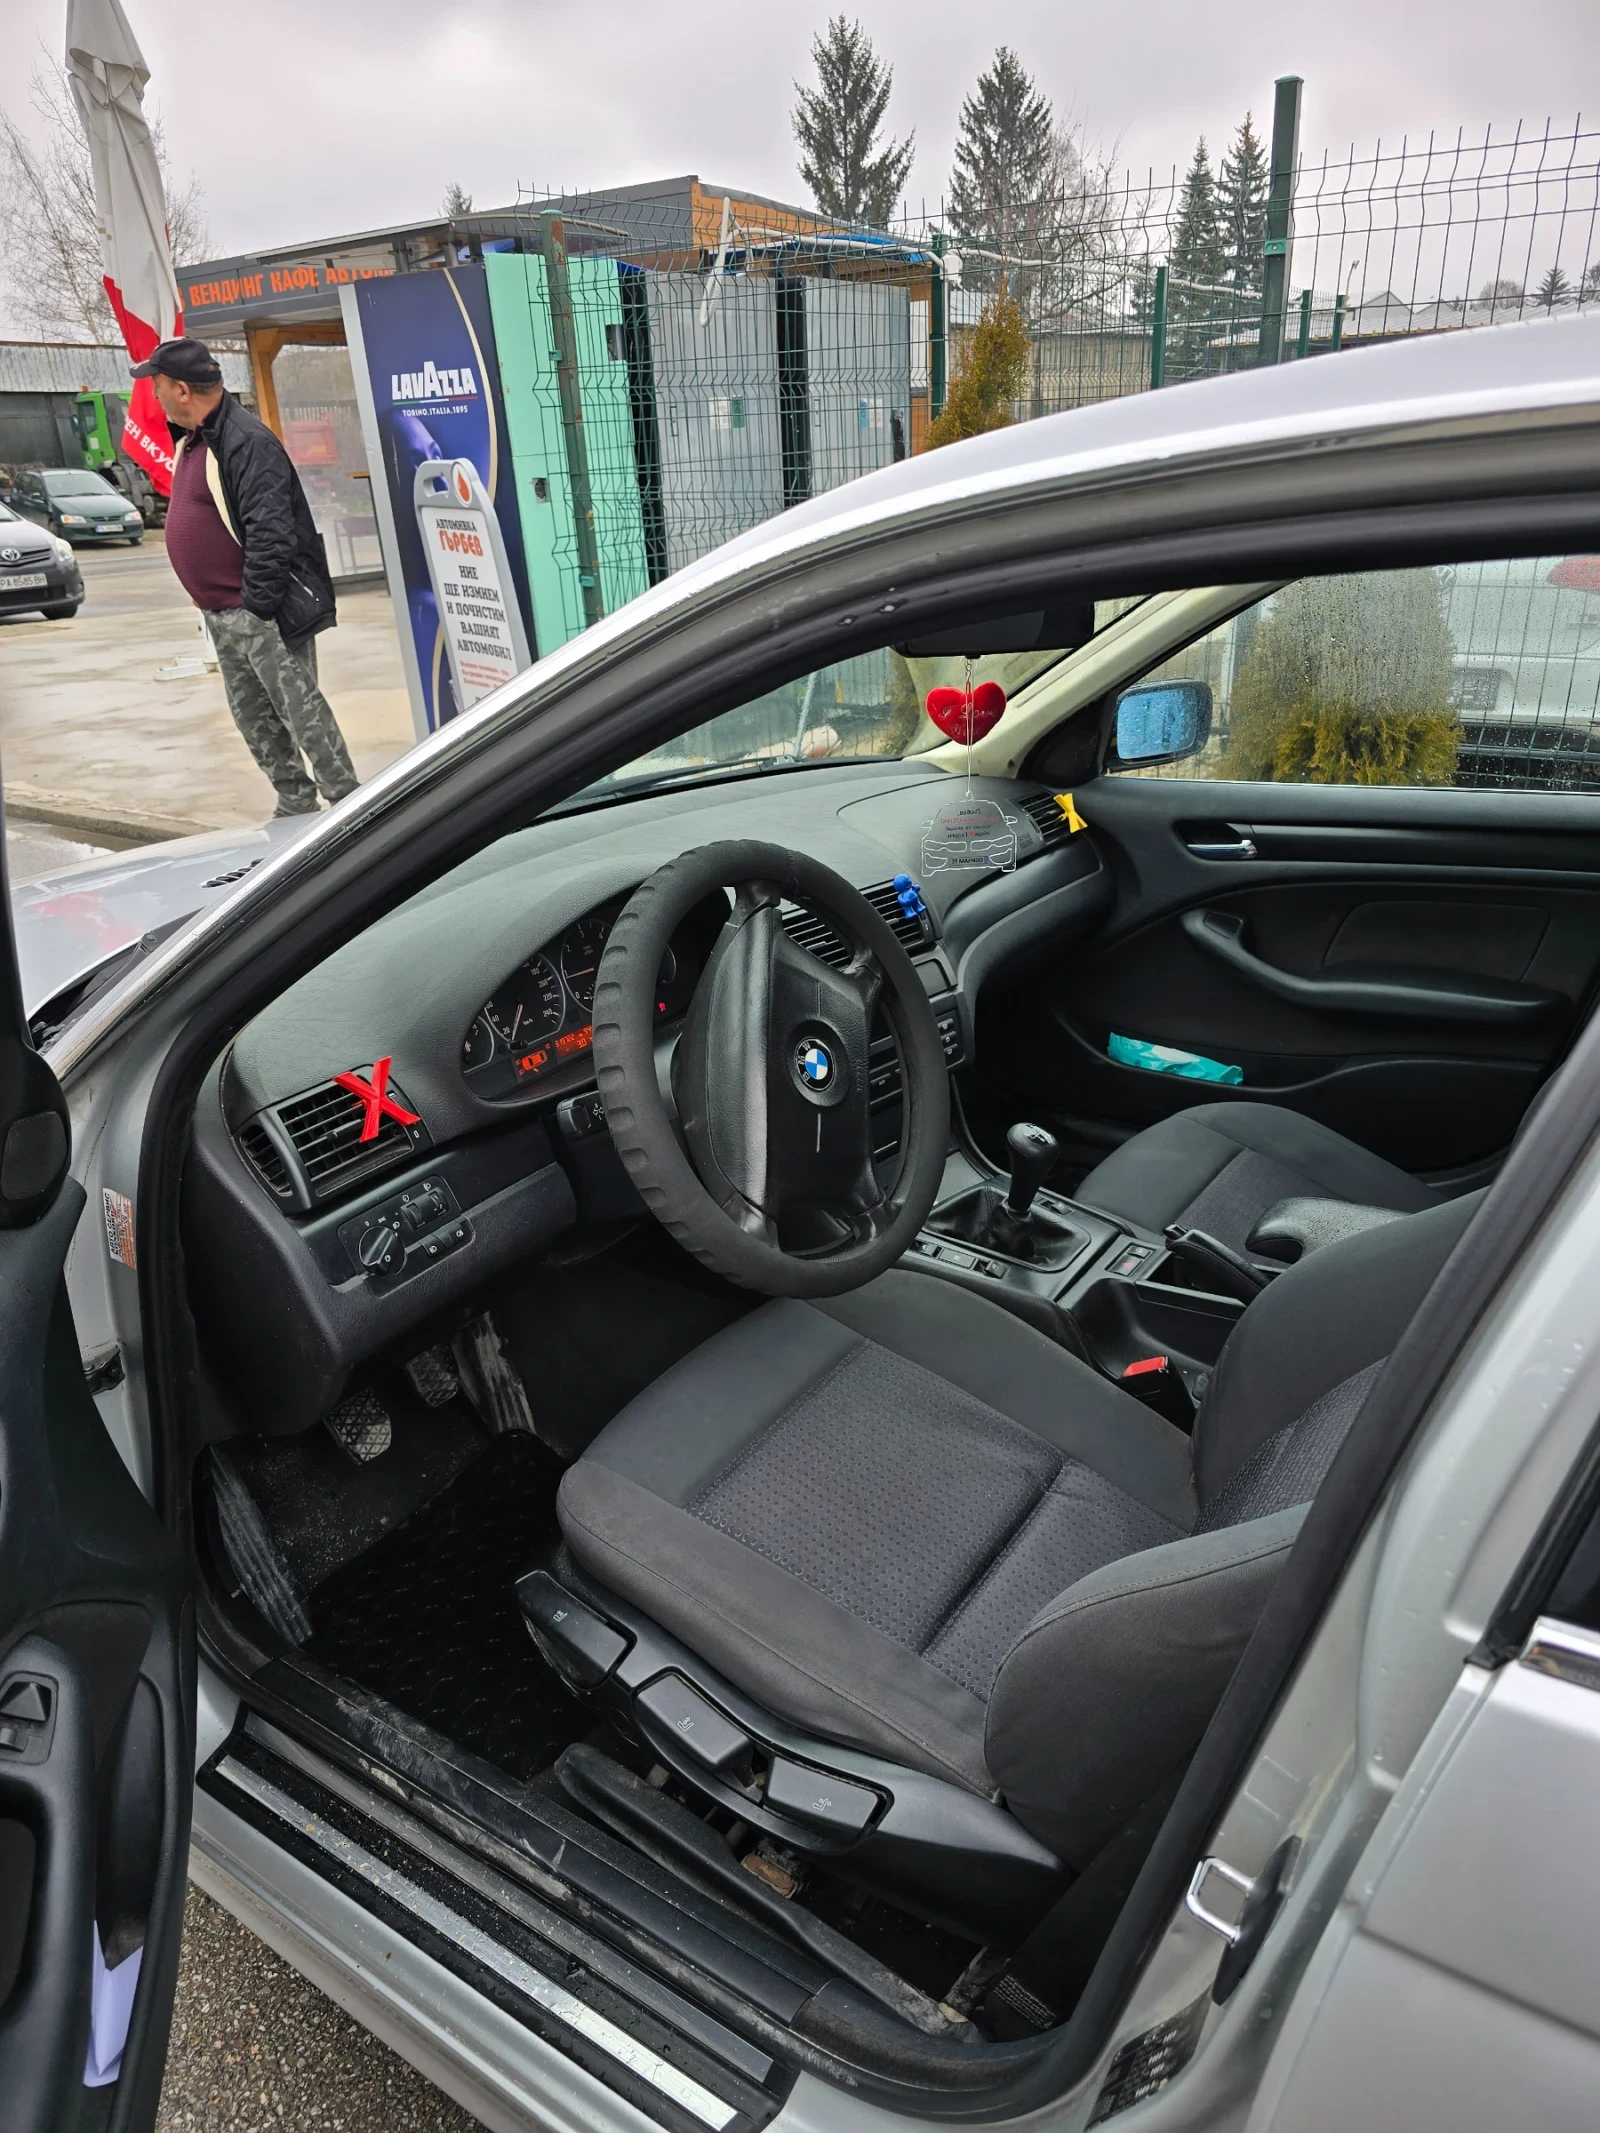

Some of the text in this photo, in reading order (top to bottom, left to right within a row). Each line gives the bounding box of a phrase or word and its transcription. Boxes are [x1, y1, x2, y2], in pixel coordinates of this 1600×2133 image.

[189, 273, 265, 307] ВЕНДИНГ
[270, 267, 320, 294] КАФЕ
[391, 361, 477, 400] LAVAZZA
[436, 518, 478, 532] АВТОМИВКА
[459, 565, 479, 580] НИЕ
[443, 582, 501, 603] ЩЕ ИЗМИЕМ
[446, 601, 506, 623] И ПОЧИСТИМ
[459, 621, 500, 640] ВАШИЯТ
[457, 639, 512, 661] АВТОМОБИЛ
[538, 979, 549, 988] 200
[502, 1026, 511, 1035] 20
[797, 1041, 812, 1082] BMW
